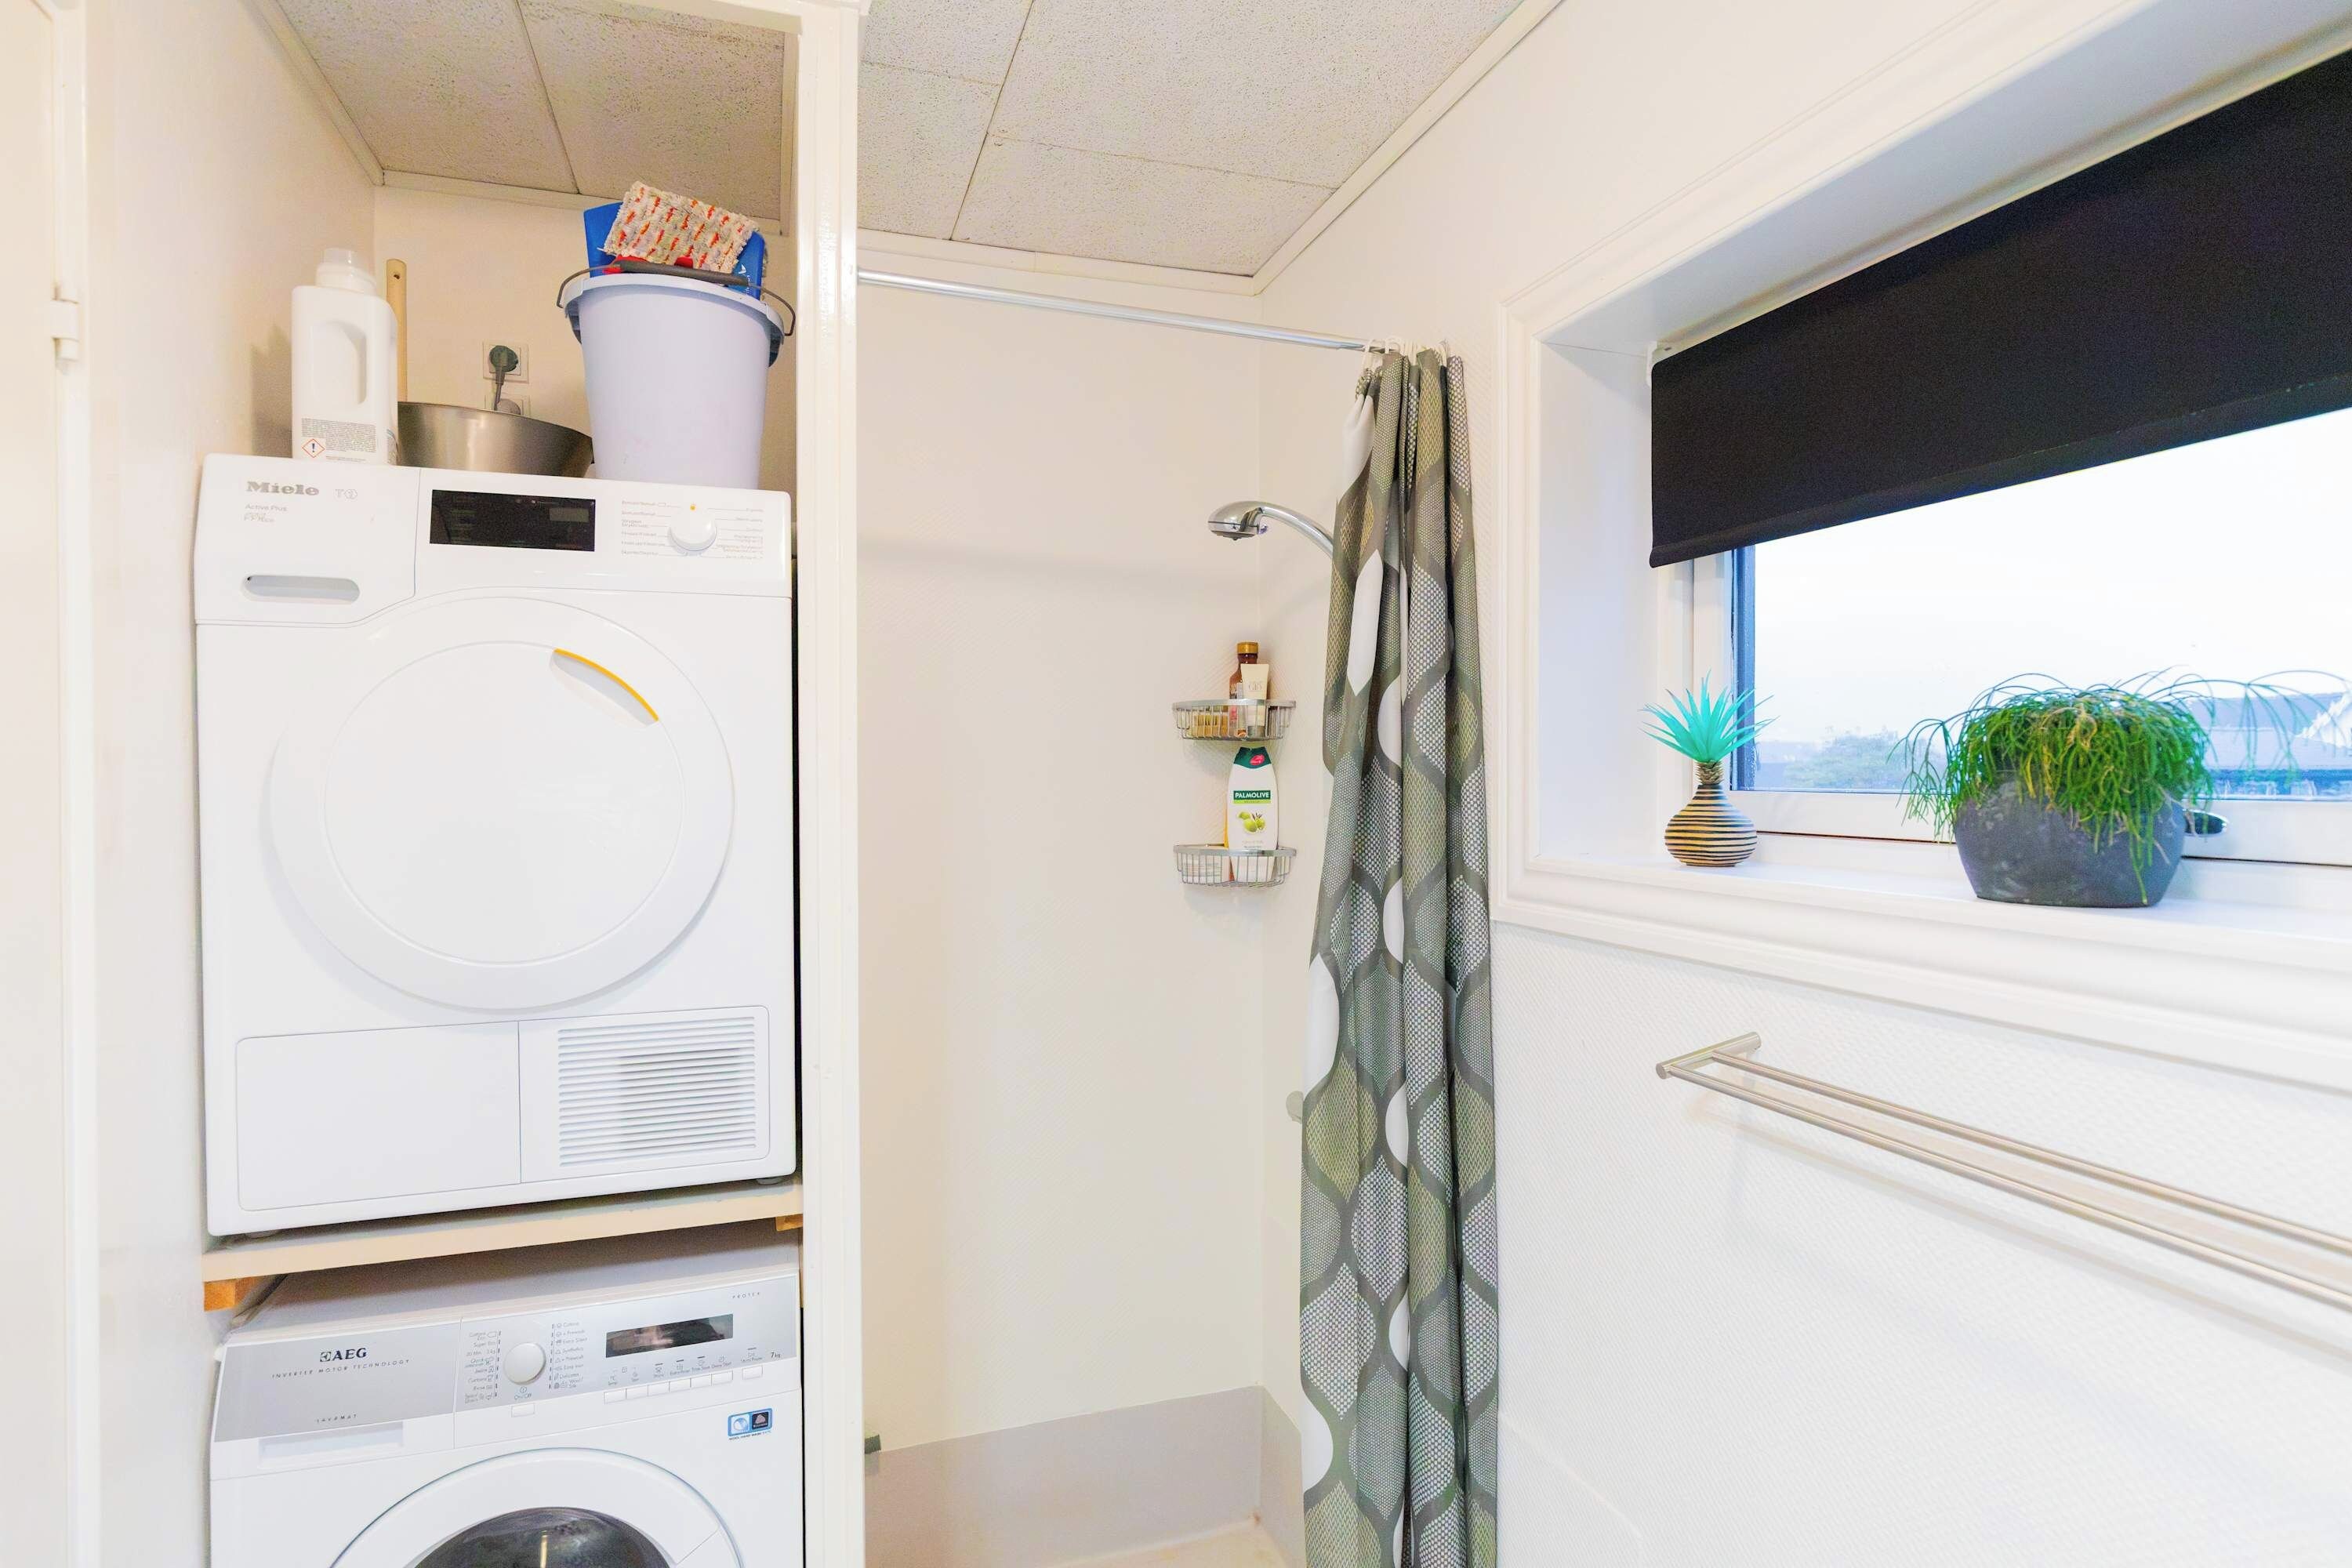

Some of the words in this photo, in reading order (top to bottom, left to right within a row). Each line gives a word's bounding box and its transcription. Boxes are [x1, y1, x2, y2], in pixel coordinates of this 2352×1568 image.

[246, 481, 320, 495] Miele
[332, 1348, 368, 1362] AEG
[271, 1370, 314, 1379] INVERTER
[318, 1365, 348, 1374] MOTOR
[353, 1359, 410, 1370] TECHNOLOGY
